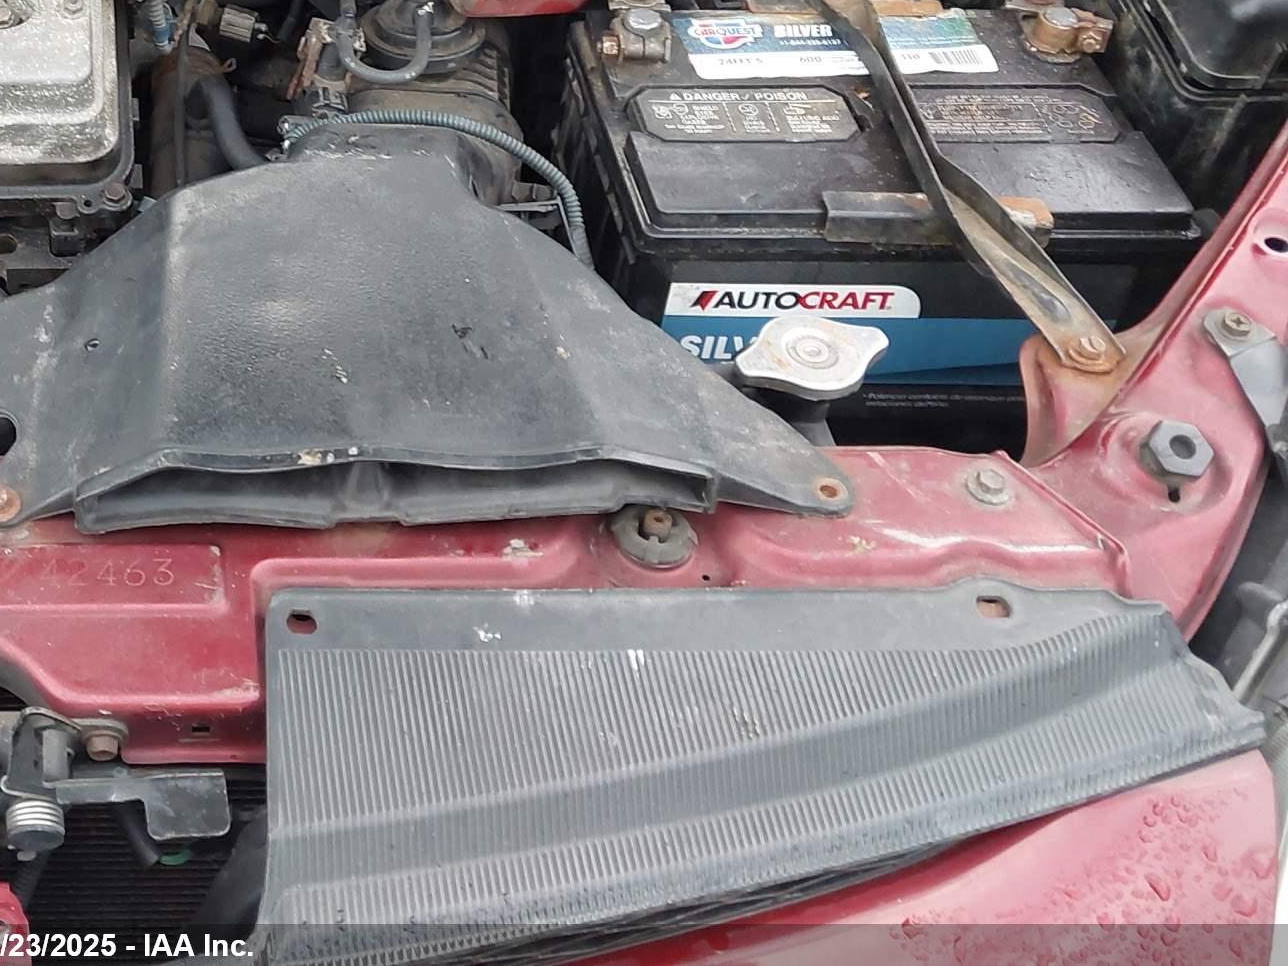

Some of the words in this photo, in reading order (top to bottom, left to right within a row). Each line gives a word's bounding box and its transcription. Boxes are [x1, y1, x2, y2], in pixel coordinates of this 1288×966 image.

[682, 93, 743, 101] DANGER
[755, 92, 808, 101] POISON
[715, 291, 894, 311] AUTOCRAFT
